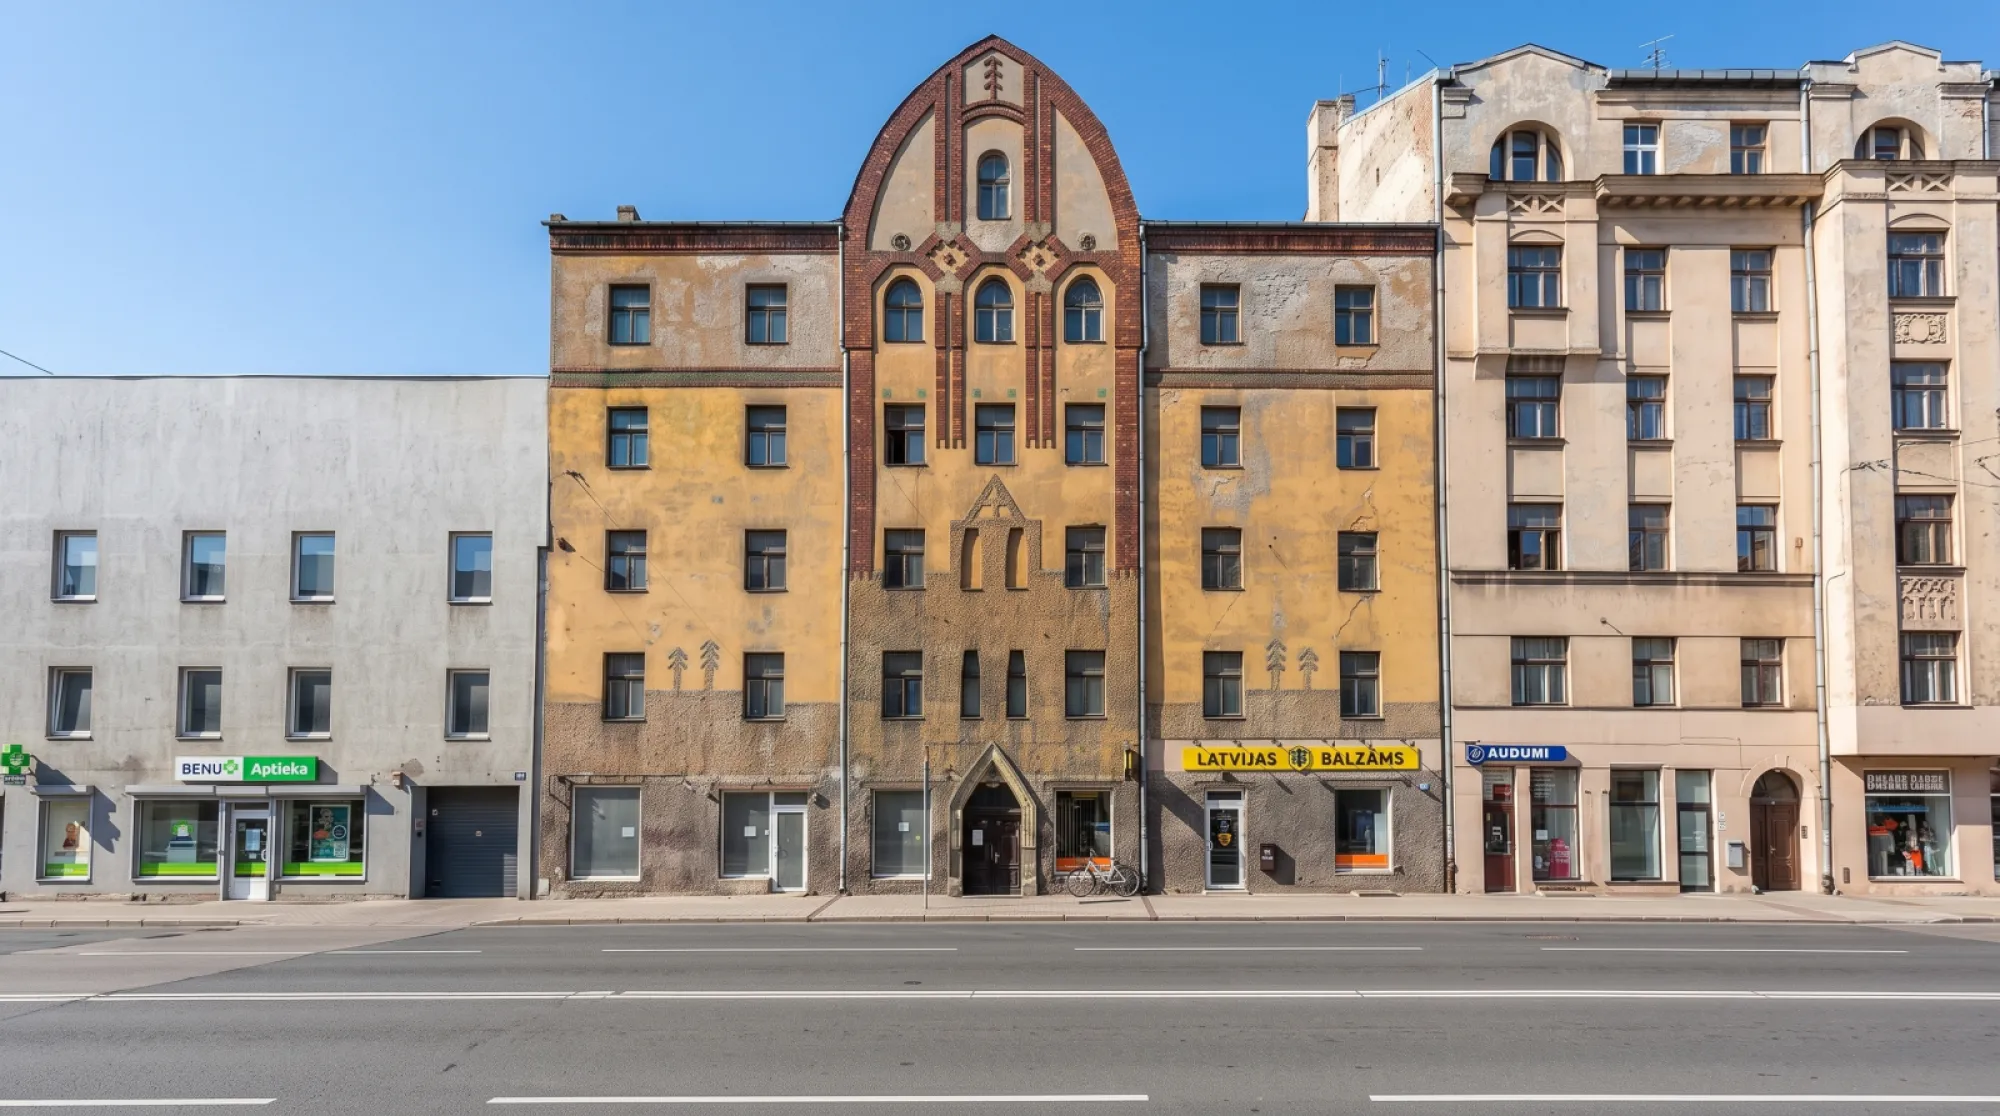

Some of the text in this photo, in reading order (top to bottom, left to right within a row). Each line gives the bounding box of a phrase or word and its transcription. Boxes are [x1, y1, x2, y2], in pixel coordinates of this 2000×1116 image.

[1197, 752, 1277, 766] LATVIJAS
[1488, 747, 1550, 759] AUDUMI
[182, 761, 308, 778] BENU Aptieka
